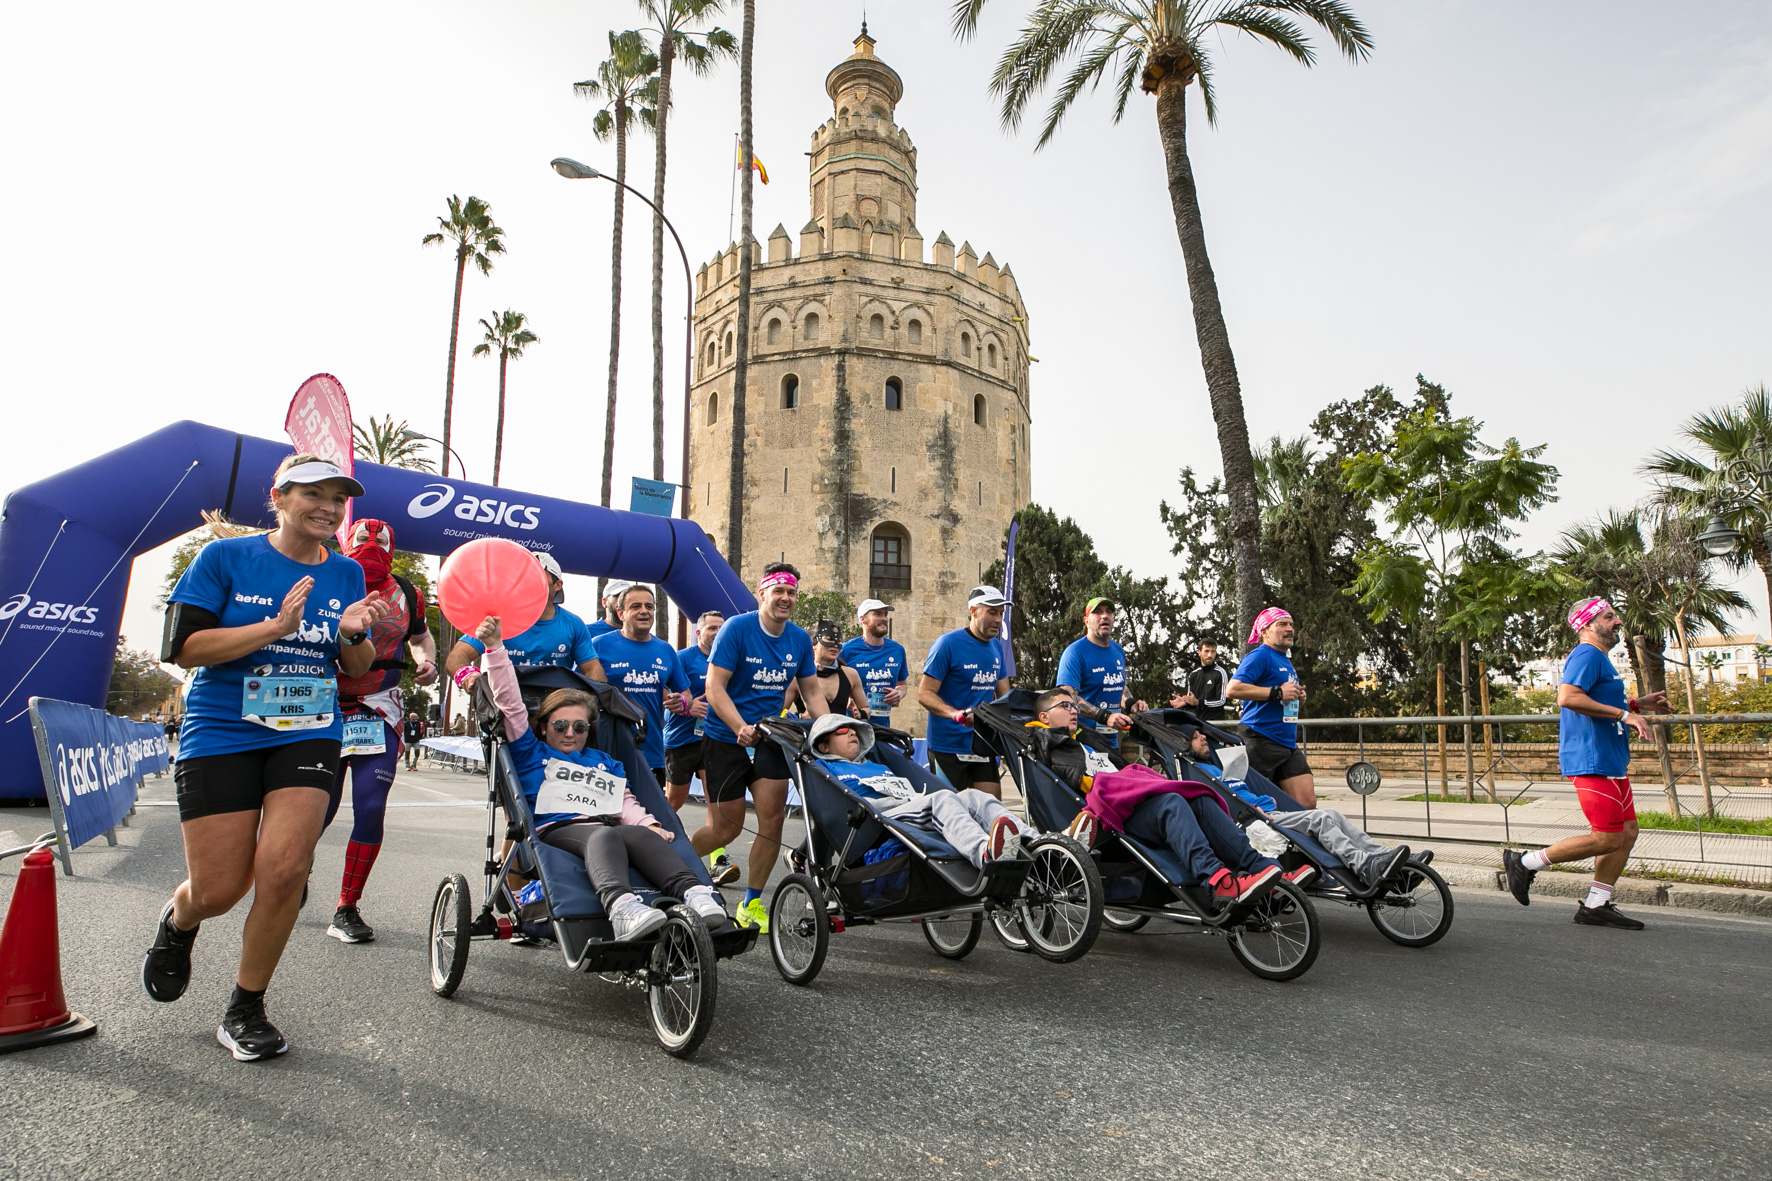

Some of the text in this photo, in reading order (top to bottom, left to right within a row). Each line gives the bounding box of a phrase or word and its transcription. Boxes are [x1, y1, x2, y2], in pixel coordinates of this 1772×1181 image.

[454, 495, 541, 530] asics
[443, 528, 475, 539] sound
[530, 539, 554, 552] body
[235, 593, 273, 606] aefat
[28, 601, 100, 624] asics
[318, 608, 342, 621] ZURIC
[19, 623, 45, 631] sound
[67, 628, 90, 636] sound
[90, 629, 105, 639] body
[610, 661, 630, 669] aefat
[745, 656, 763, 664] aefat
[278, 664, 324, 675] ZURICH
[274, 686, 312, 698] 11965
[752, 683, 784, 691] #Imparables
[280, 704, 305, 714] KRIS
[345, 726, 368, 736] 11517
[69, 746, 99, 796] asics
[556, 766, 616, 795] aefat
[566, 793, 597, 808] SARA
